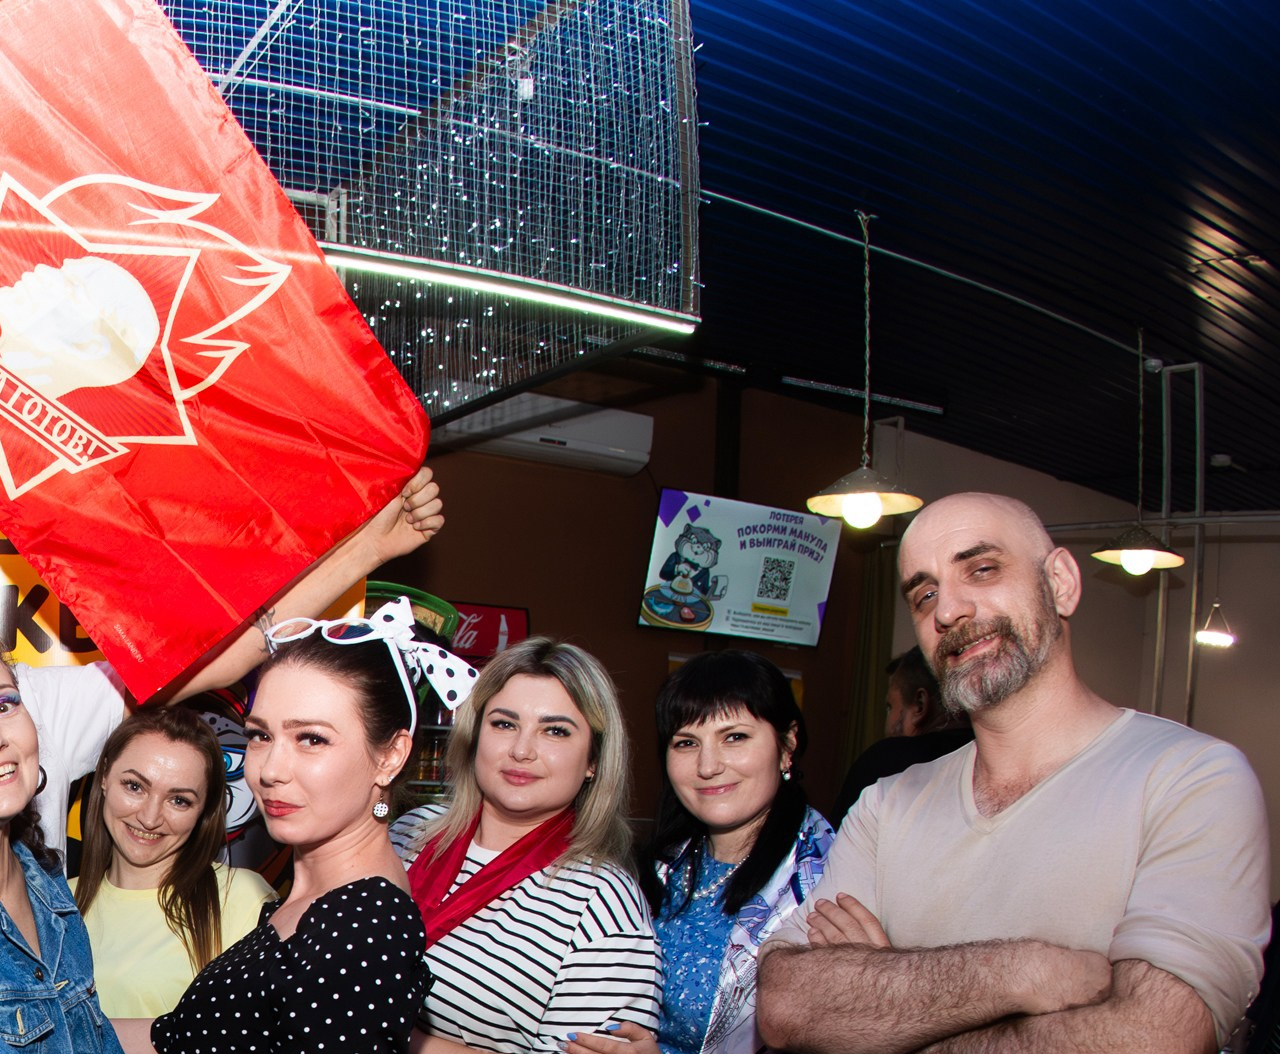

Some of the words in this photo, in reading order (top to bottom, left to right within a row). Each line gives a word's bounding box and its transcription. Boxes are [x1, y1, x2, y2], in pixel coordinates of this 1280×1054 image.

[8, 385, 102, 463] ГОТОВ!
[769, 511, 804, 525] ЛОТЕРЕЯ
[737, 524, 788, 538] ПОКОРМИ
[788, 527, 828, 553] МАНУЛА
[740, 539, 747, 551] И
[749, 538, 797, 552] ВЫИГРАЙ
[797, 543, 824, 564] ПРИЗ!
